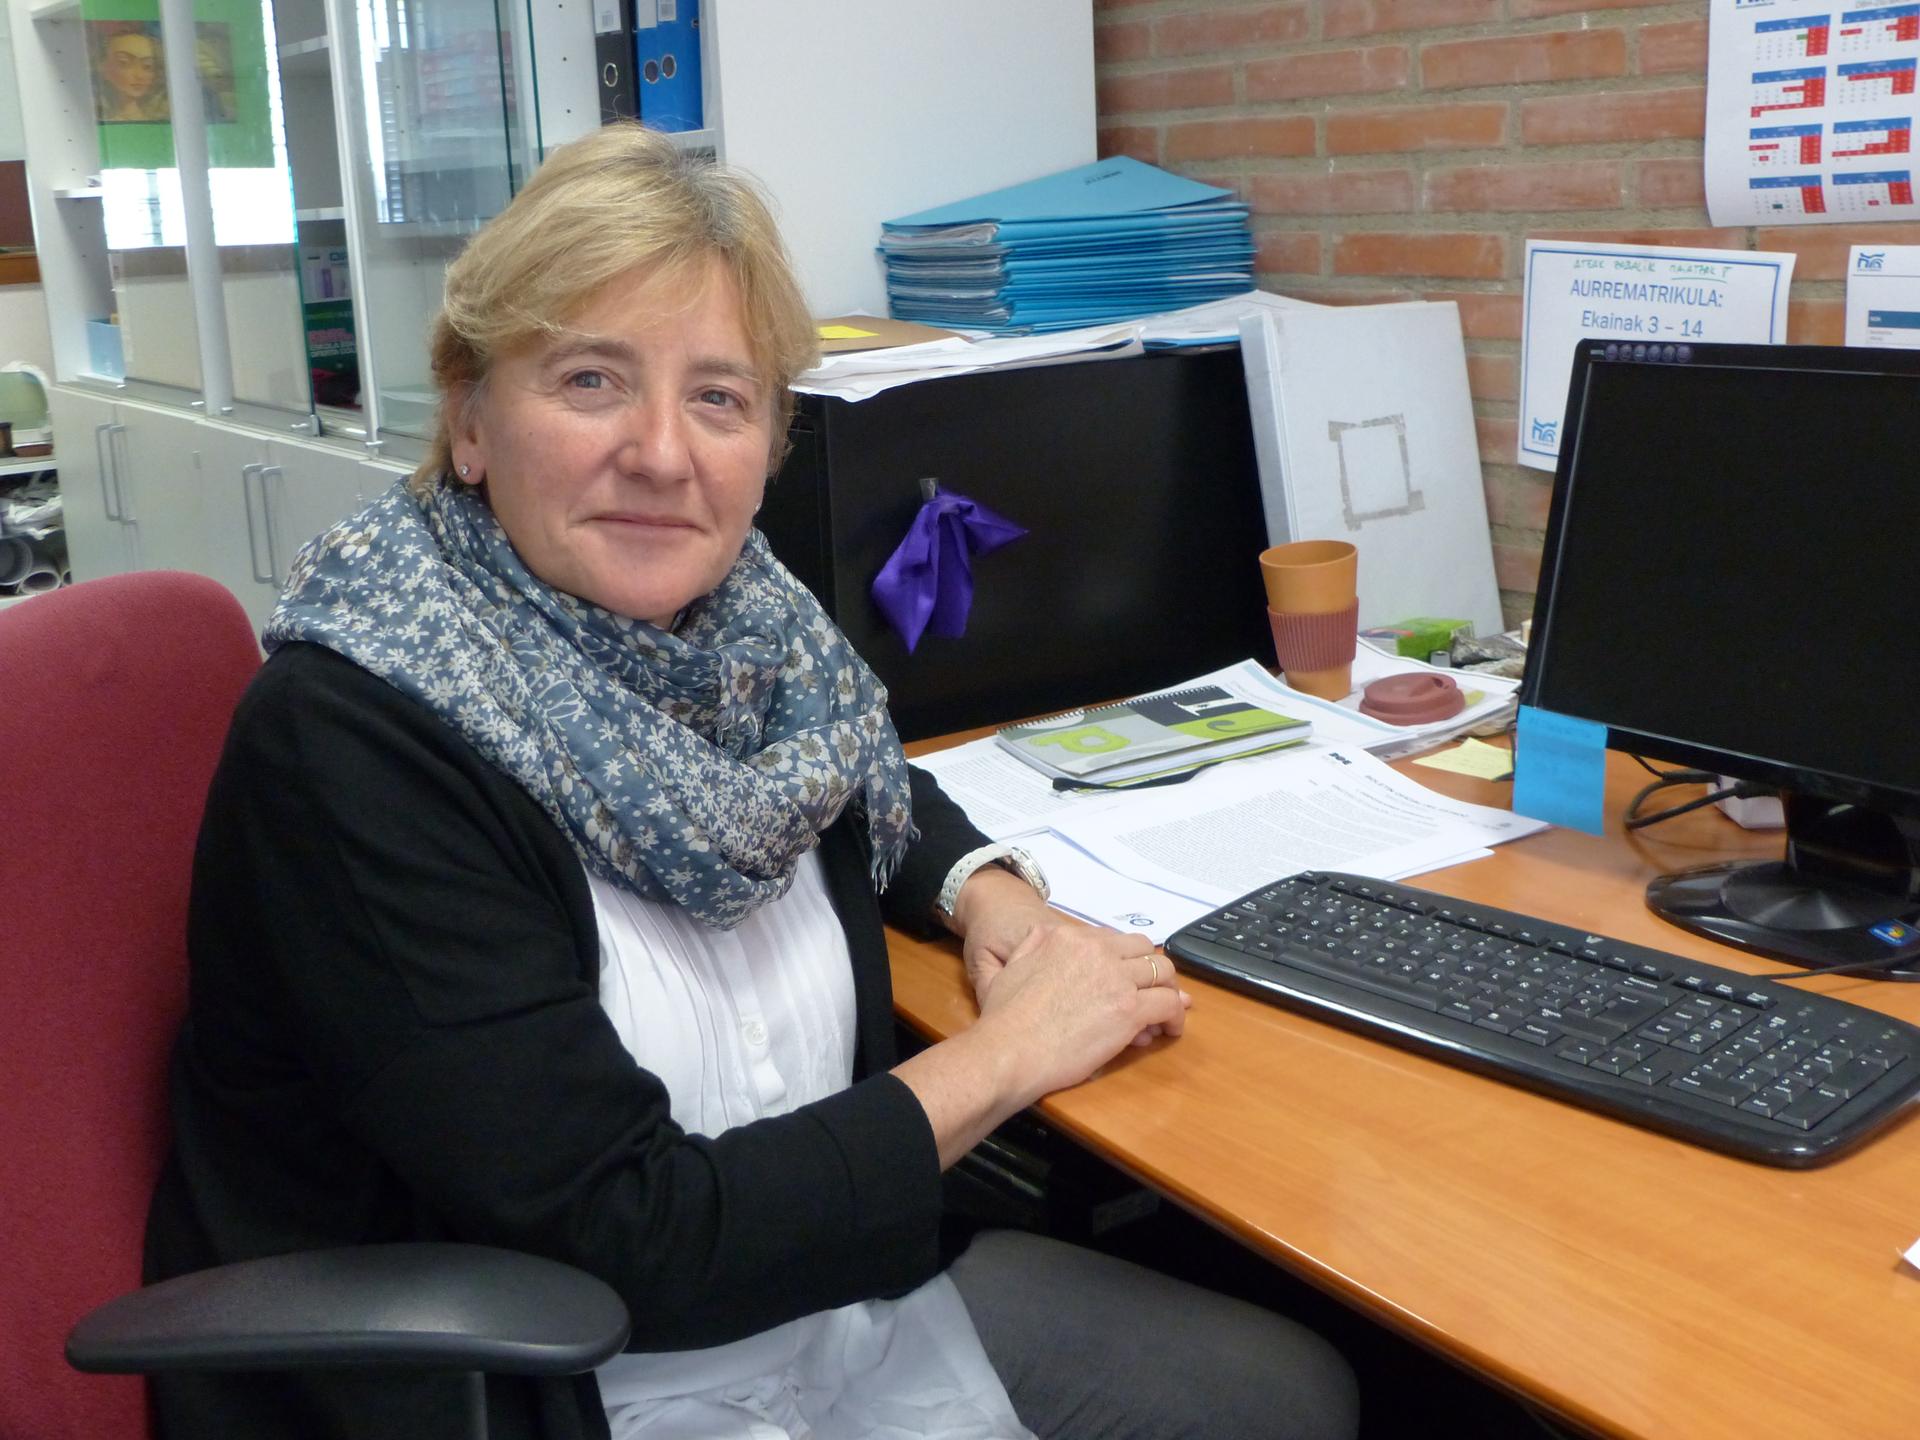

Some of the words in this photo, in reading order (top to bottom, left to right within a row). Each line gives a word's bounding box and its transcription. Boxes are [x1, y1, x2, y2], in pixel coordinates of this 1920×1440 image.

[1570, 279, 1724, 308] AURREMATRIKULA:
[1581, 310, 1643, 333] Ekainak
[1647, 315, 1659, 334] 3
[1680, 319, 1704, 338] 14
